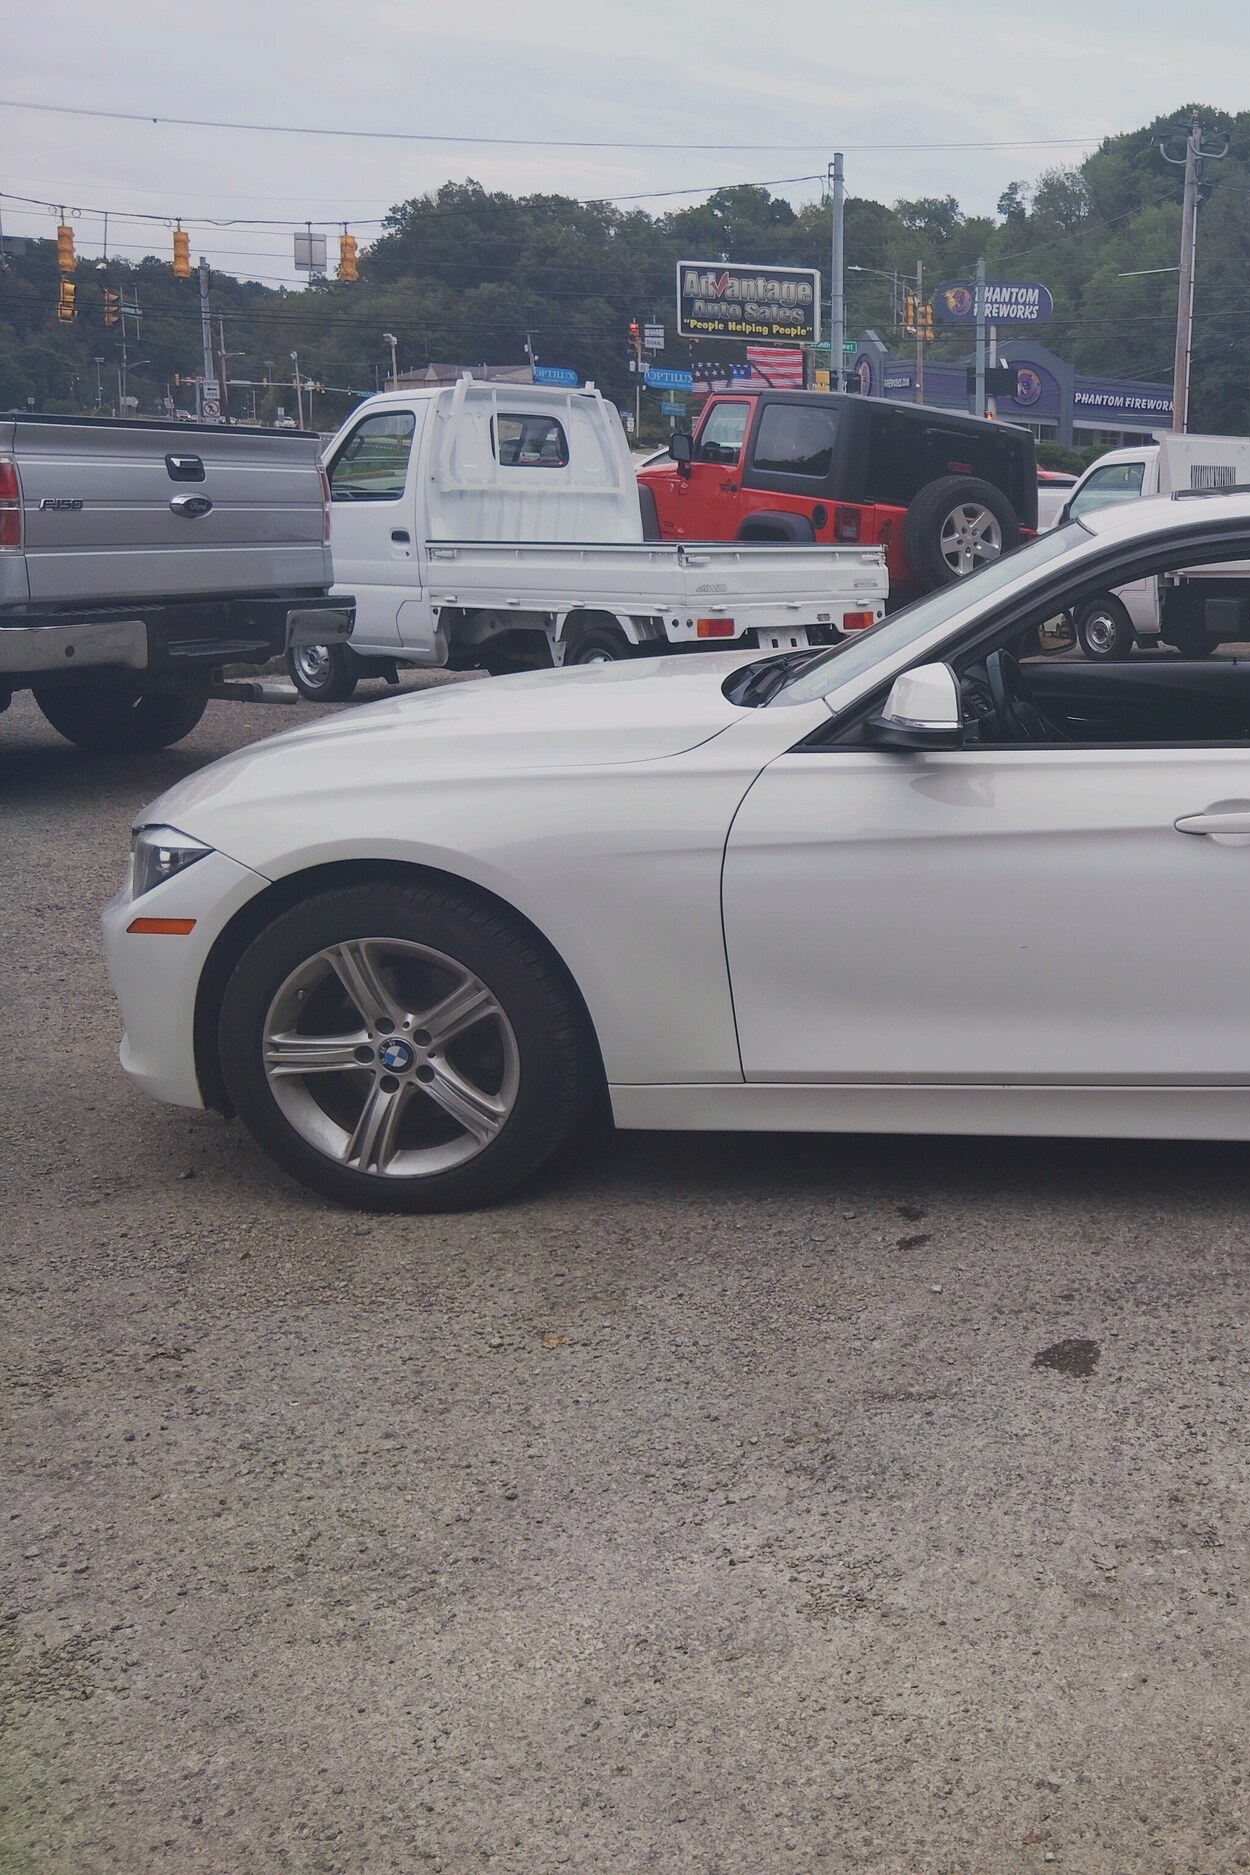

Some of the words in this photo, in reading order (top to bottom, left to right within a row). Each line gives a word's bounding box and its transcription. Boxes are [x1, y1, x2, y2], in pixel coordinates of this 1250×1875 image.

[683, 271, 812, 307] Advantage
[692, 300, 742, 319] Auto
[744, 303, 805, 324] Sales
[728, 322, 768, 335] Helping
[1075, 393, 1123, 407] PHANTOM
[1125, 397, 1175, 411] FIREWORK
